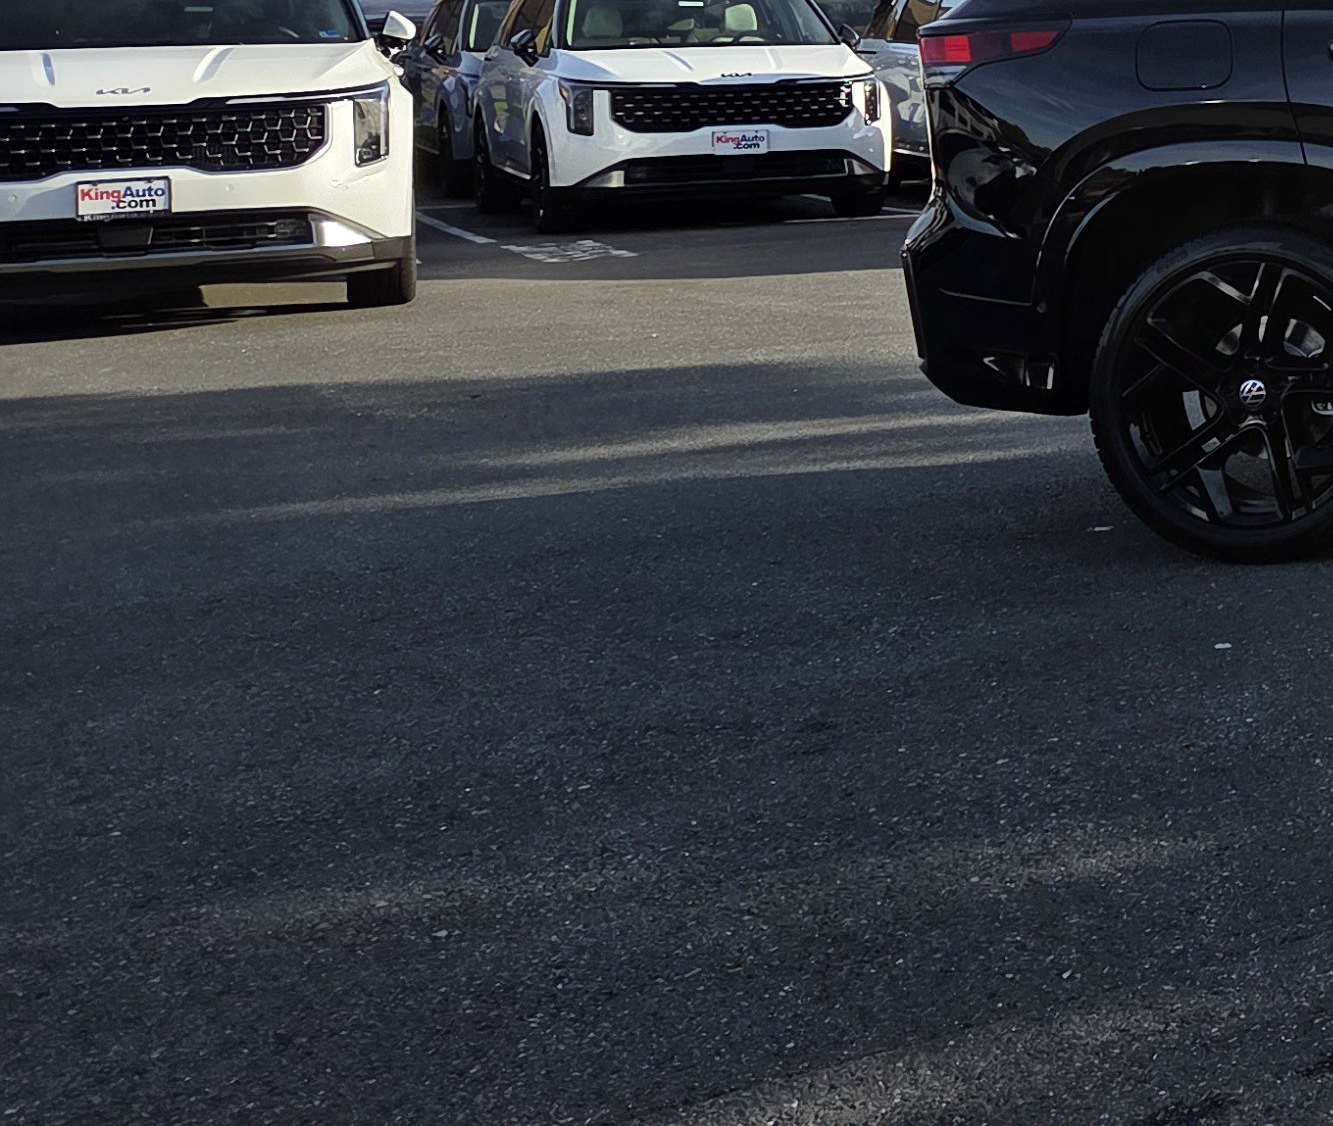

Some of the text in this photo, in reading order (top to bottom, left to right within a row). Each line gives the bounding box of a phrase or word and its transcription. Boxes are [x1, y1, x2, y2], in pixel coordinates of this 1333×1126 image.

[716, 134, 765, 145] KingAuto
[80, 185, 166, 203] KingAuto
[111, 198, 157, 210] .com
